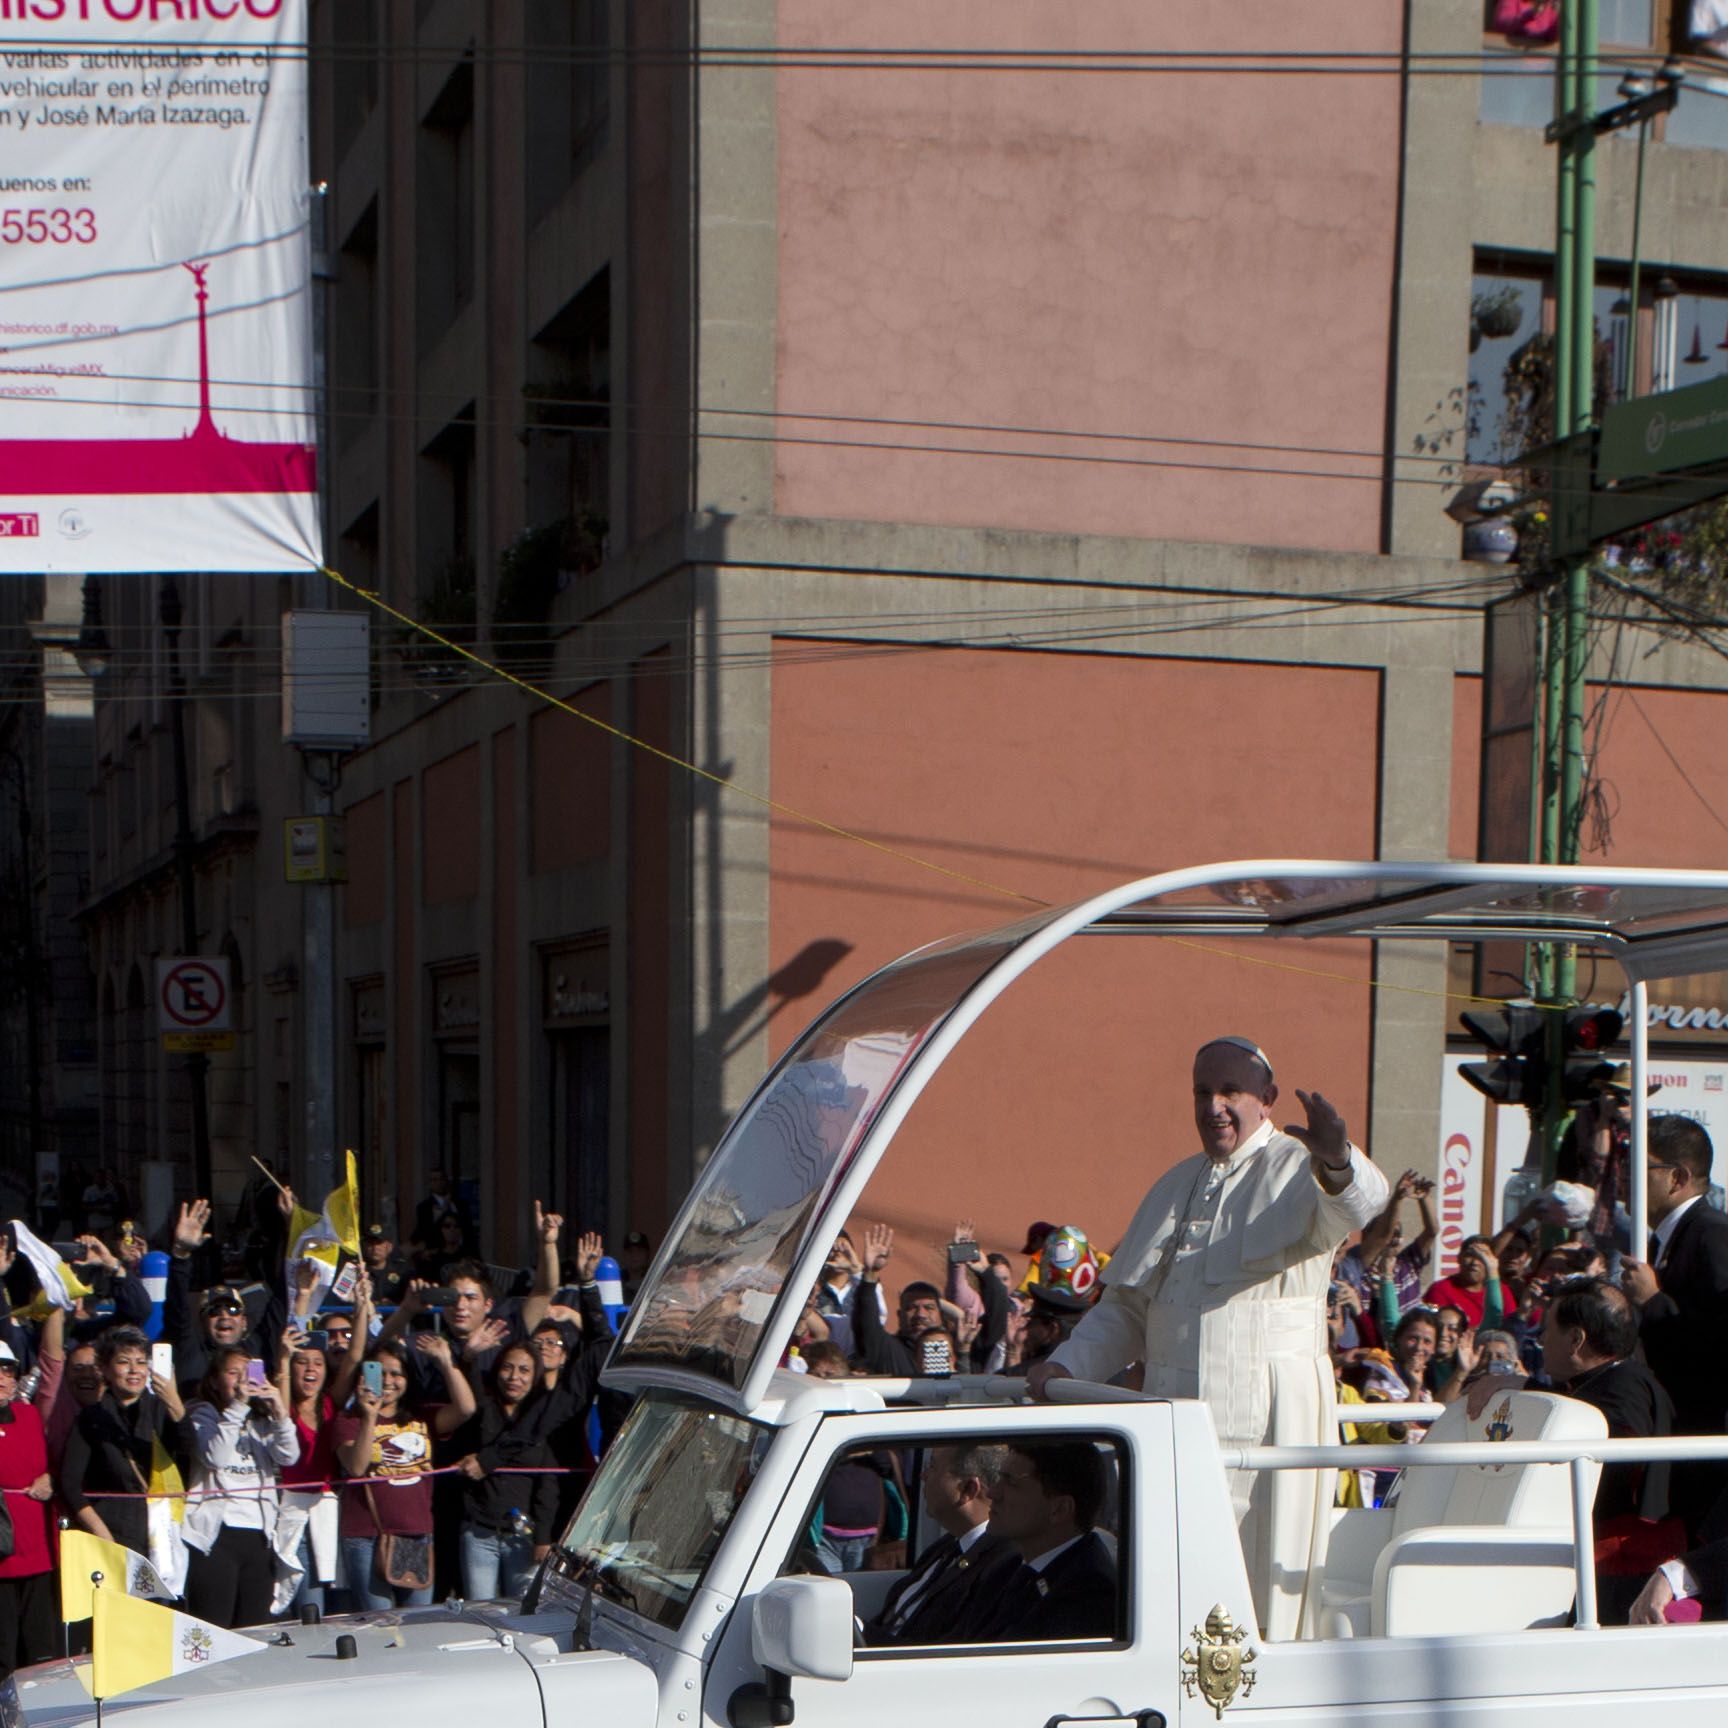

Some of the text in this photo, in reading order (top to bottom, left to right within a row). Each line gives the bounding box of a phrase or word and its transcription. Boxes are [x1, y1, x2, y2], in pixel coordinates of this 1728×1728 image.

[4, 49, 69, 69] varias
[81, 46, 203, 70] actividades
[215, 52, 241, 69] en
[252, 46, 271, 69] el
[1, 75, 97, 98] vehicular
[108, 80, 134, 98] en
[142, 75, 161, 98] el
[167, 75, 270, 102] perímetro
[19, 110, 30, 130] y
[37, 105, 88, 126] José
[96, 106, 156, 127] María
[162, 107, 251, 130] Izazaga.
[62, 176, 91, 192] en:
[16, 515, 37, 535] Ti
